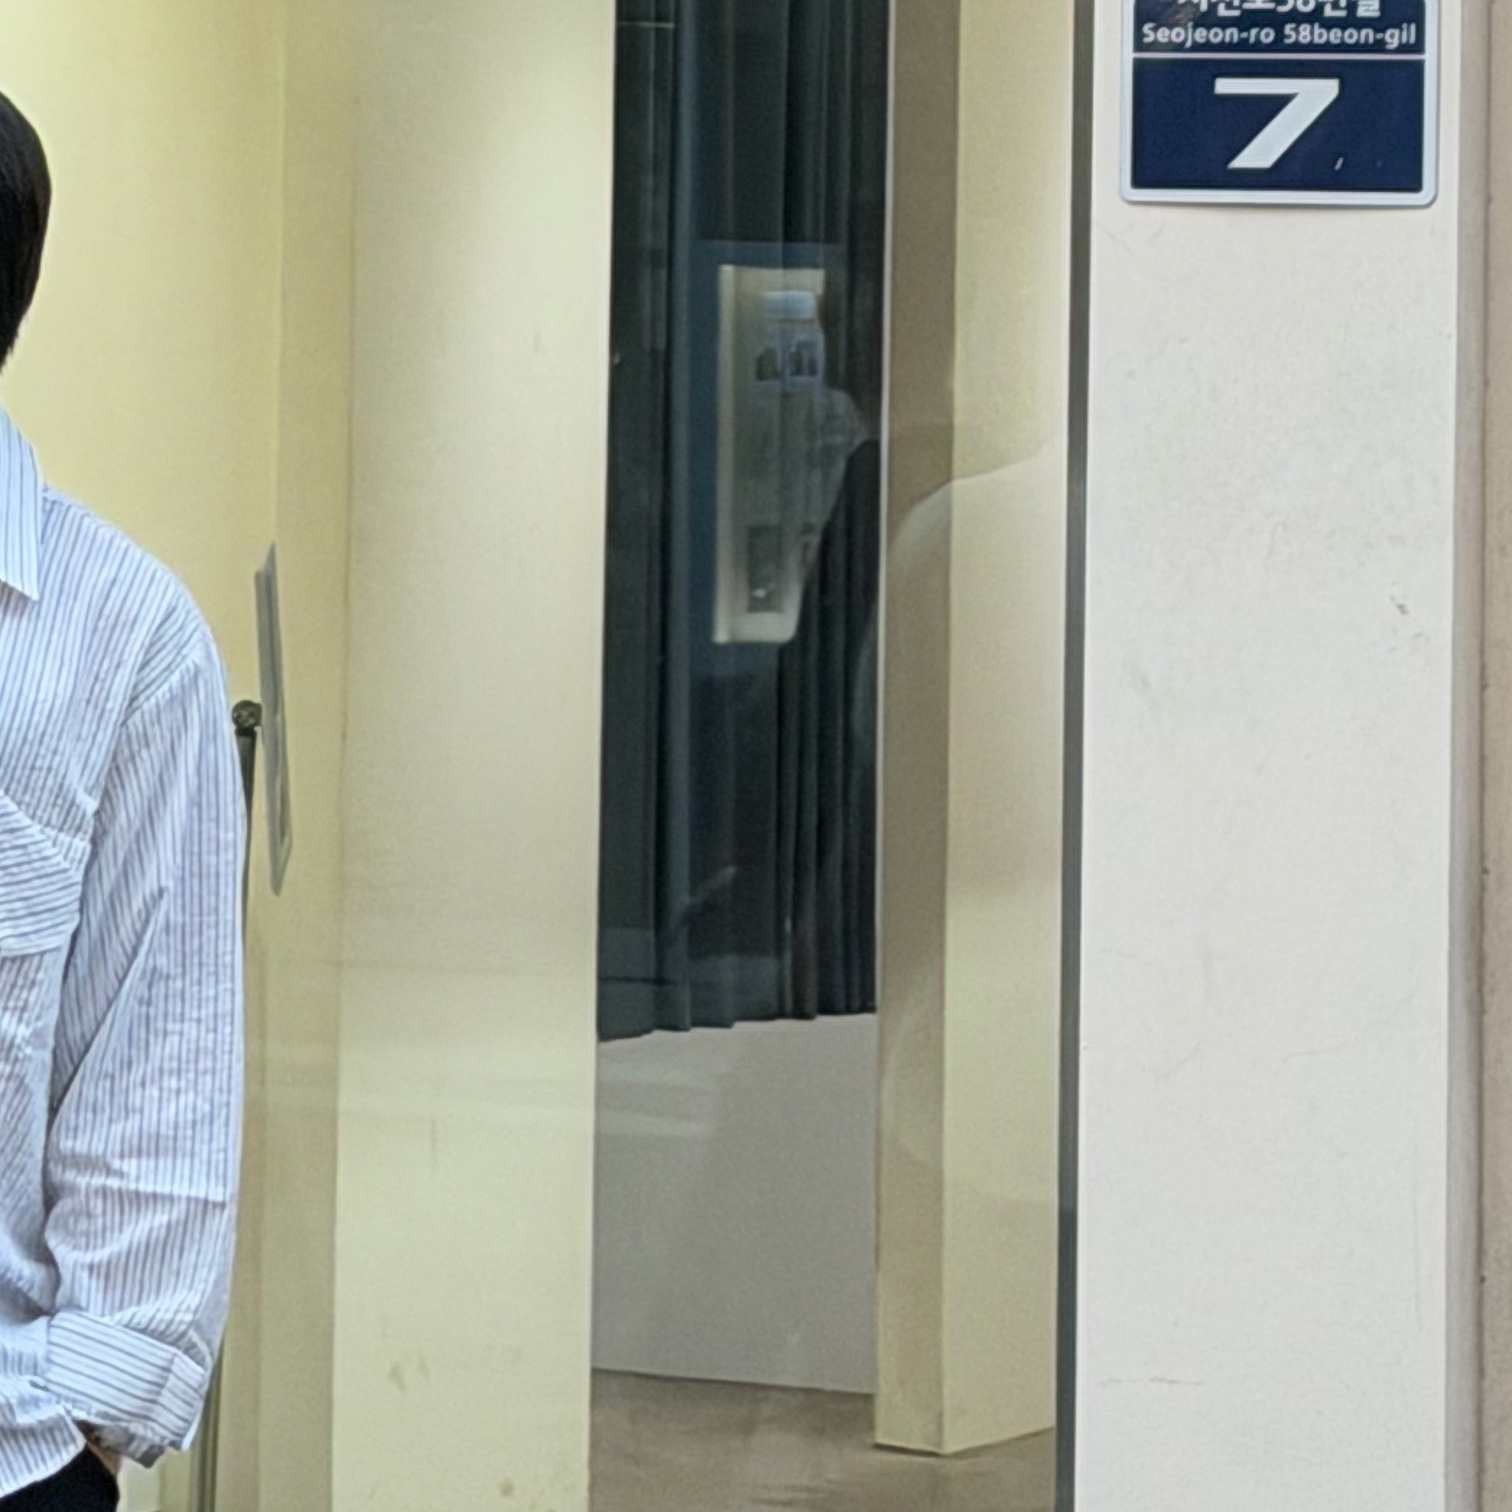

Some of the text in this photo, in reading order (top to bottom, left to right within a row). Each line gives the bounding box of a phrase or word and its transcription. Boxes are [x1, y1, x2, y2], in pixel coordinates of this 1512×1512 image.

[1141, 21, 1416, 50] Seojeon-ro 58beon-gil
[1214, 77, 1341, 169] 7
